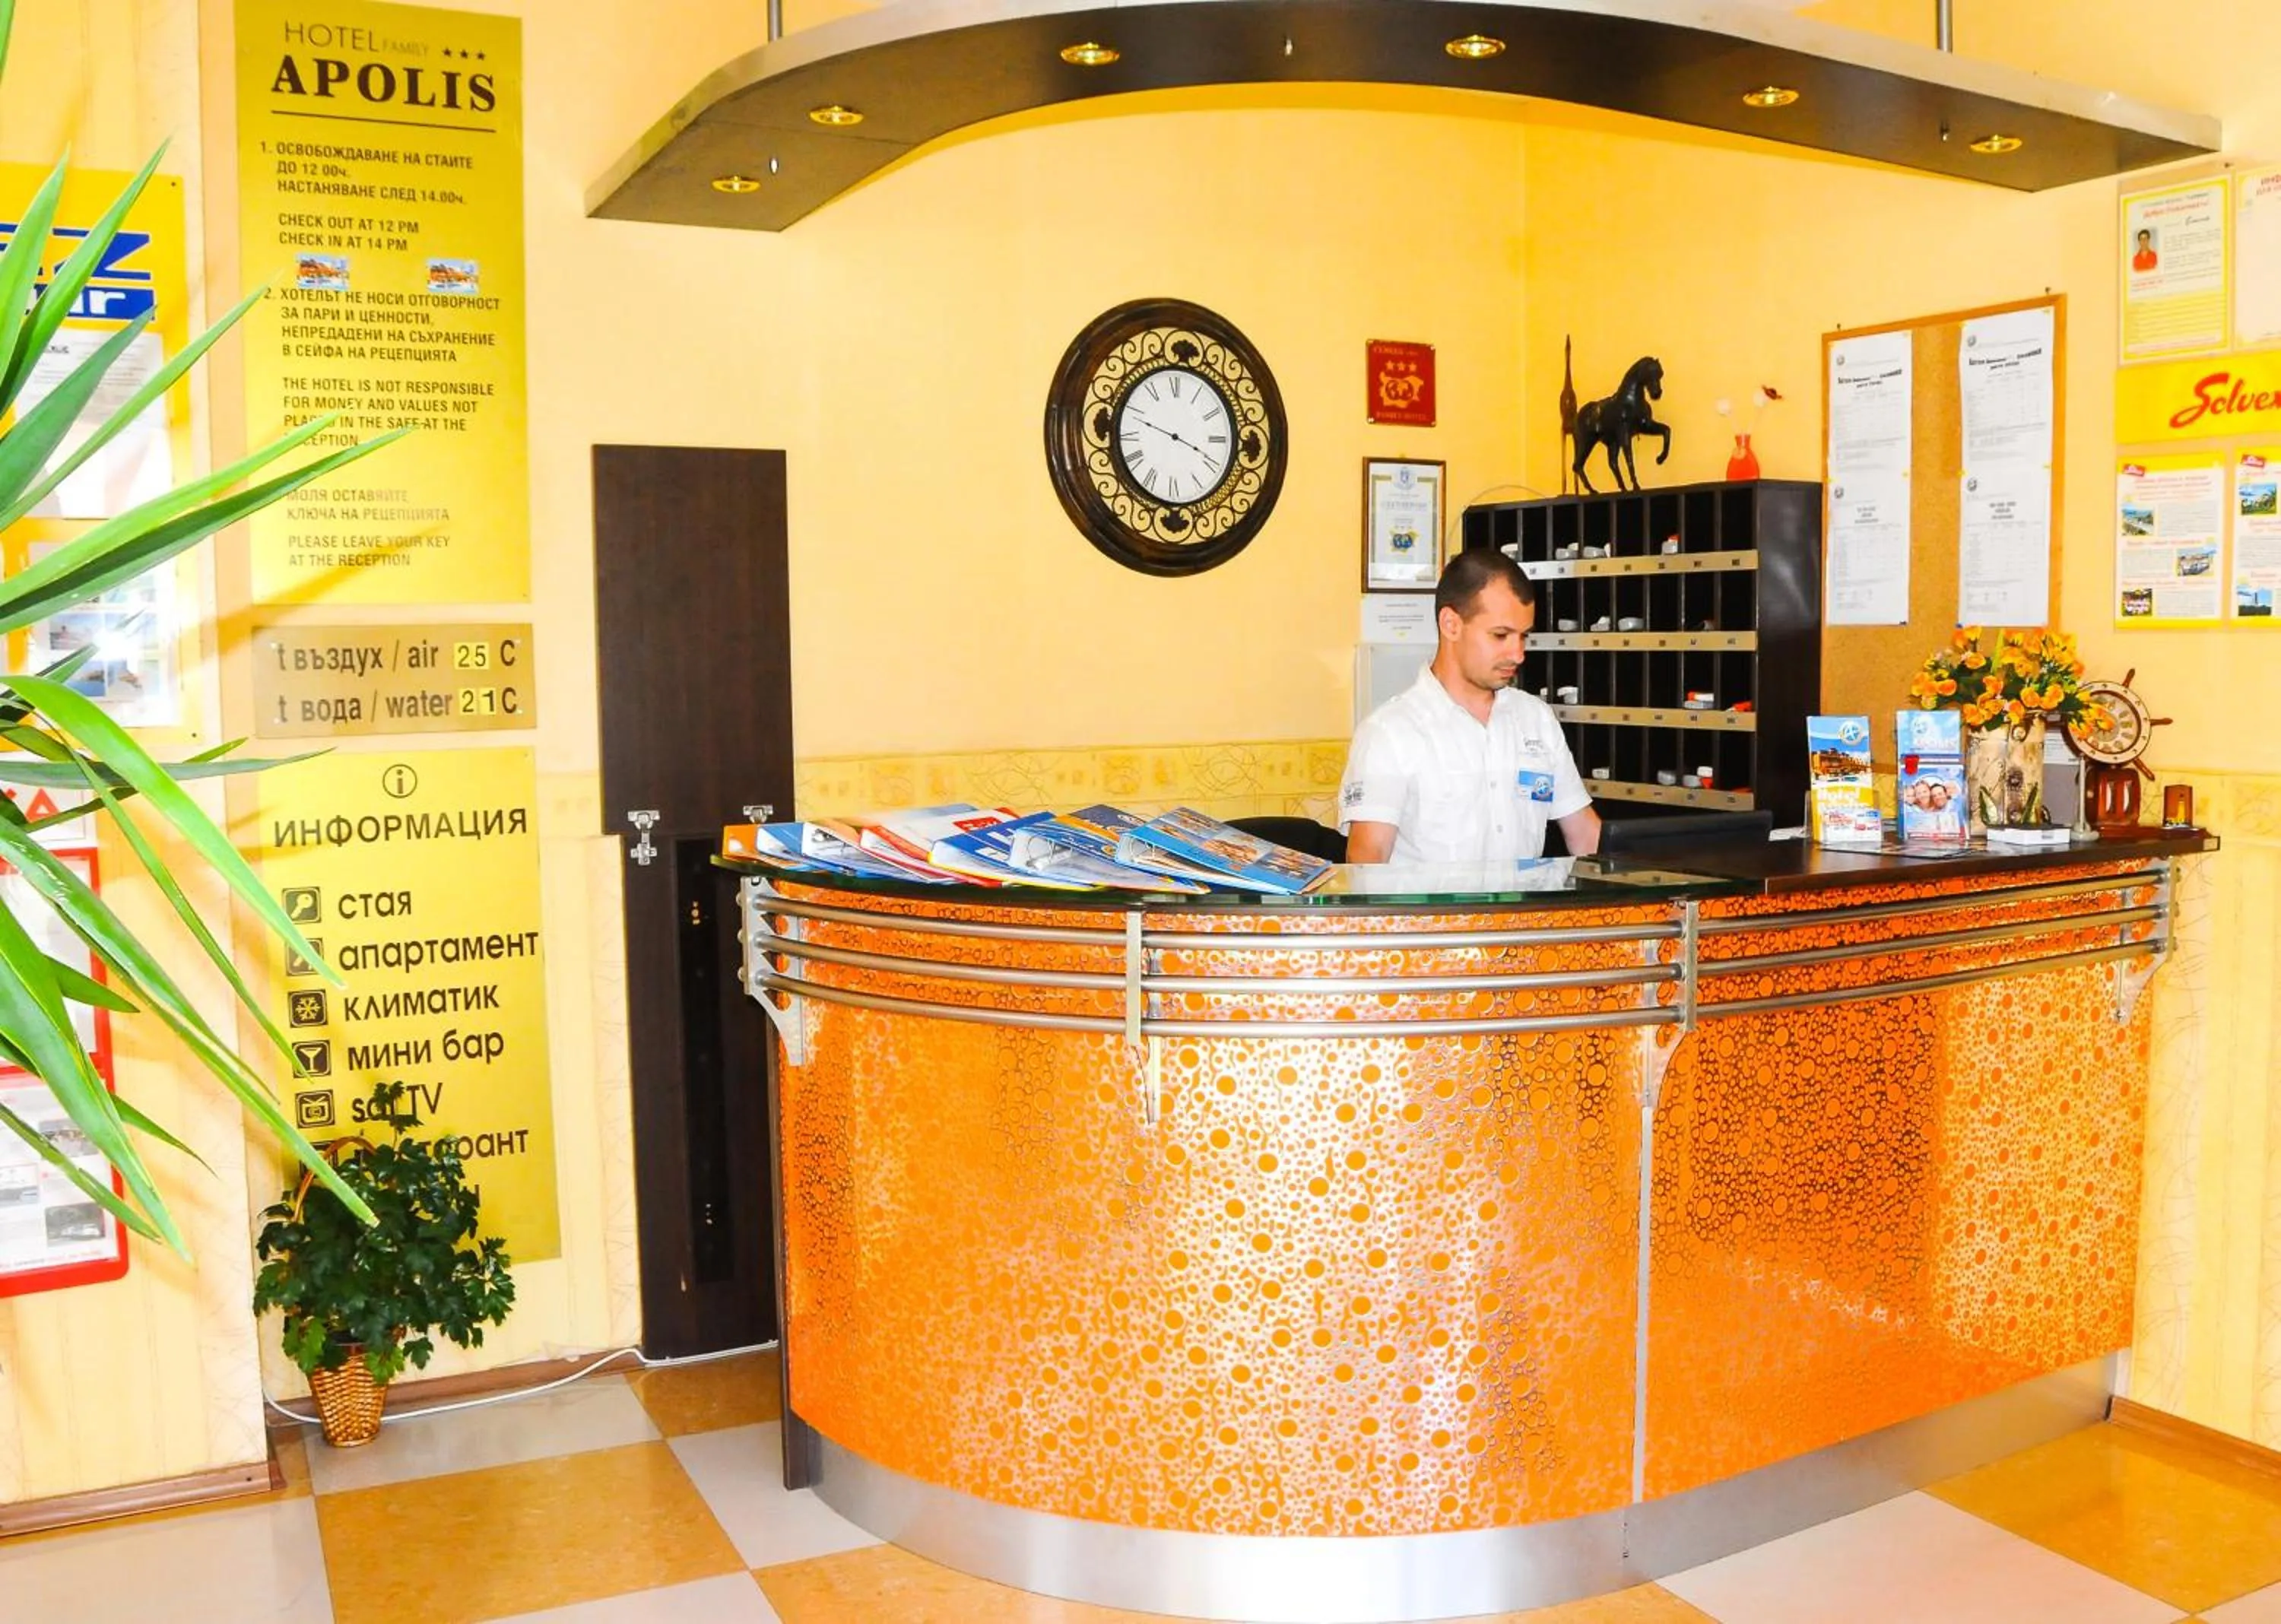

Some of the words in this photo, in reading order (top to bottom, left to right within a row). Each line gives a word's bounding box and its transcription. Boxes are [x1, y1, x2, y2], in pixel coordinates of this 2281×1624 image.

[284, 20, 381, 53] HOTEL
[382, 40, 430, 58] FAMILY
[271, 54, 496, 113] APOLIS
[277, 142, 398, 163] ОСВОБОЖДАВАНЕ
[404, 152, 420, 165] НА
[277, 160, 297, 174] ДО
[278, 180, 375, 198] НАСТАНЯВАНЕ
[380, 186, 416, 201] СЛЕД
[279, 213, 322, 227] CHECK
[328, 216, 353, 229] OUT
[358, 218, 373, 230] AT
[379, 220, 394, 232] 12
[398, 220, 419, 233] PM
[279, 232, 323, 246] CHECK
[328, 233, 342, 247] IN
[347, 236, 362, 249] AT
[368, 237, 382, 249] 14
[387, 238, 408, 251] PM
[346, 291, 363, 303] НЕ
[367, 292, 404, 305] НОСИ
[408, 295, 500, 310] ОТГОВОРНОСТ
[281, 306, 299, 319] ЗА
[304, 308, 340, 321] ПАРИ
[345, 309, 354, 322] И
[282, 325, 382, 343] НЕПРЕДАДЕНИ
[387, 329, 405, 342] НА
[282, 344, 291, 357] В
[296, 344, 343, 358] СЕЙФА
[347, 347, 366, 359] НА
[370, 347, 456, 363] РЕЦЕПЦИЯТА
[283, 377, 308, 391] THE
[312, 378, 354, 392] HOTEL
[358, 380, 371, 392] IS
[376, 380, 401, 394] NOT
[406, 381, 494, 397] RESPONSIBLE
[284, 396, 310, 410] FOR
[315, 397, 363, 411] MONEY
[367, 398, 395, 411] AND
[398, 398, 448, 413] VALUES
[453, 400, 477, 414] NOT
[284, 414, 335, 429] PLA
[340, 415, 354, 429] IN
[359, 416, 382, 430] THE
[424, 417, 438, 431] AT
[443, 417, 466, 431] THE
[284, 433, 360, 446] CEPTION
[287, 507, 337, 520] КЛЮЧА
[341, 508, 358, 520] НА
[363, 508, 449, 522] РЕЦЕПЦИЯТА
[288, 535, 338, 548] PLEASE
[343, 535, 382, 548] LEAVE
[387, 536, 423, 548] YOUR
[427, 535, 450, 548] KEY
[289, 554, 303, 566] AT
[309, 554, 333, 566] THE
[338, 554, 411, 567] RECEPTION
[293, 645, 383, 677] въздух
[408, 640, 439, 668] air
[458, 645, 486, 668] 25
[301, 697, 361, 724] вода
[385, 690, 452, 718] water
[274, 808, 527, 847] ИНФОРМАЦИЯ
[338, 890, 412, 919] стая
[339, 931, 538, 973] апартамент
[344, 985, 500, 1022] климатик
[347, 1039, 432, 1071] мини
[443, 1029, 504, 1064] бар
[406, 1082, 443, 1118] TV
